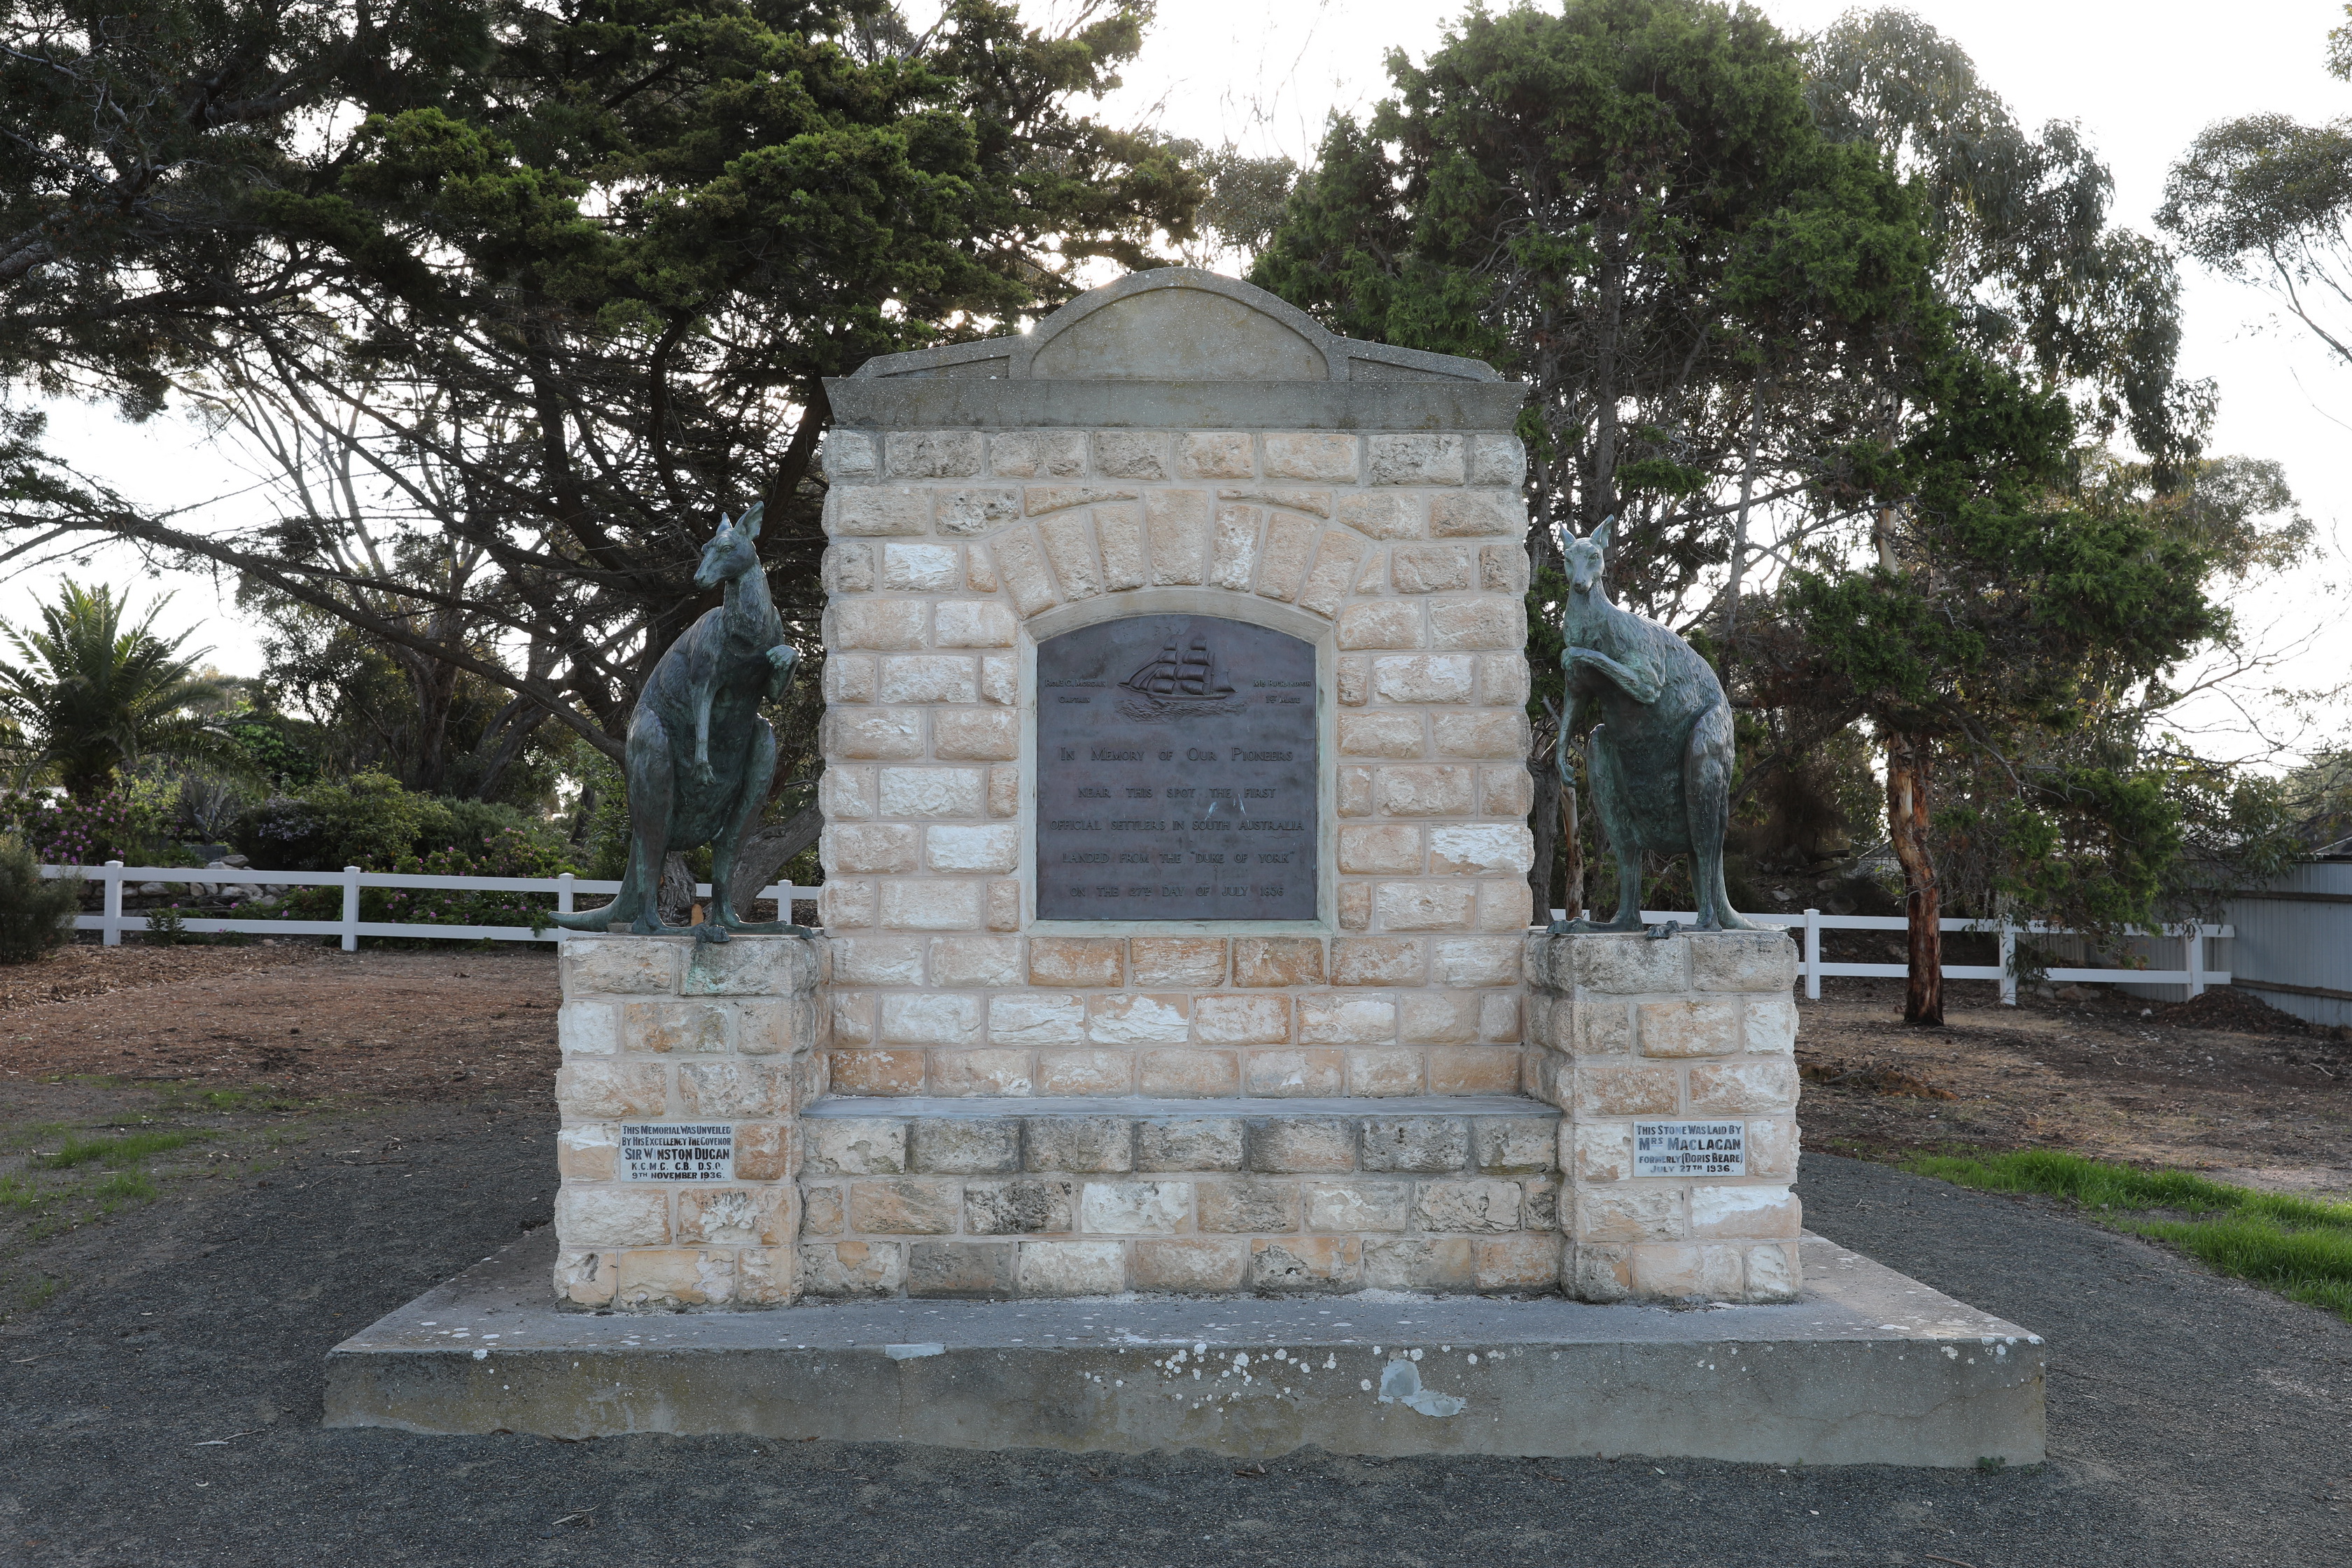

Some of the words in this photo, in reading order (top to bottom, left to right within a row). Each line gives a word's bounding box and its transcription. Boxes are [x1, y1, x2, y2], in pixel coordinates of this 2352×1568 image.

[1074, 679, 1106, 687] MORGAN
[1060, 747, 1075, 761] IN
[1091, 747, 1145, 761] MEMORY
[1158, 750, 1174, 761] OF
[1187, 747, 1217, 761] OUR
[1231, 747, 1293, 761] PIONEERS
[1078, 788, 1112, 798] NEAR
[1126, 788, 1153, 798] THIS
[1167, 788, 1196, 798] SPOT
[1209, 788, 1232, 798] THE
[1244, 788, 1276, 798] FIRST
[1050, 820, 1102, 830] OFFICIAL
[1111, 820, 1166, 830] SETTLERS
[1172, 820, 1185, 830] IN
[1192, 820, 1230, 830] SOUTH
[1238, 820, 1305, 831] AUSTRALIA
[1062, 853, 1110, 863] LANDED
[1120, 853, 1150, 863] FROM
[1159, 853, 1182, 863] THE
[1234, 853, 1248, 863] OF
[1070, 887, 1086, 897] ON
[1097, 886, 1120, 897] THE
[1130, 887, 1152, 897] 27TH
[1162, 887, 1186, 897] DAY
[1196, 887, 1211, 897] OF
[1222, 887, 1249, 897] JULY
[1260, 887, 1284, 897] 1836
[622, 1126, 640, 1135] THIS
[640, 1126, 680, 1135] MEMORIAL
[680, 1126, 696, 1135] WAS
[696, 1126, 731, 1135] UNVEILED
[1637, 1126, 1656, 1135] THIS
[1658, 1125, 1687, 1135] STONE
[1688, 1125, 1707, 1135] WAS
[1707, 1125, 1727, 1135] LAID
[1728, 1125, 1742, 1135] BY
[622, 1137, 631, 1146] BY
[633, 1137, 645, 1146] HIS
[645, 1137, 687, 1147] EXCELLENCY
[688, 1137, 701, 1146] THE
[701, 1137, 732, 1146] GOVENOR
[1639, 1137, 1663, 1151] MRS
[1667, 1138, 1742, 1151] MACLAGAN
[624, 1148, 642, 1160] SIR
[644, 1148, 694, 1162] WINSTON
[694, 1148, 730, 1161] DUGAN
[1639, 1155, 1681, 1163] FORMERLY
[1681, 1152, 1711, 1165] (DORIS
[1712, 1152, 1743, 1165] BEARE)
[675, 1162, 692, 1170] C.B.
[698, 1162, 724, 1171] D.S.O.
[1651, 1165, 1675, 1173] JULY
[1680, 1164, 1703, 1172] 27TH
[1707, 1164, 1735, 1172] 1936.
[651, 1172, 698, 1181] NOVEMBER
[700, 1172, 725, 1181] 1936.
